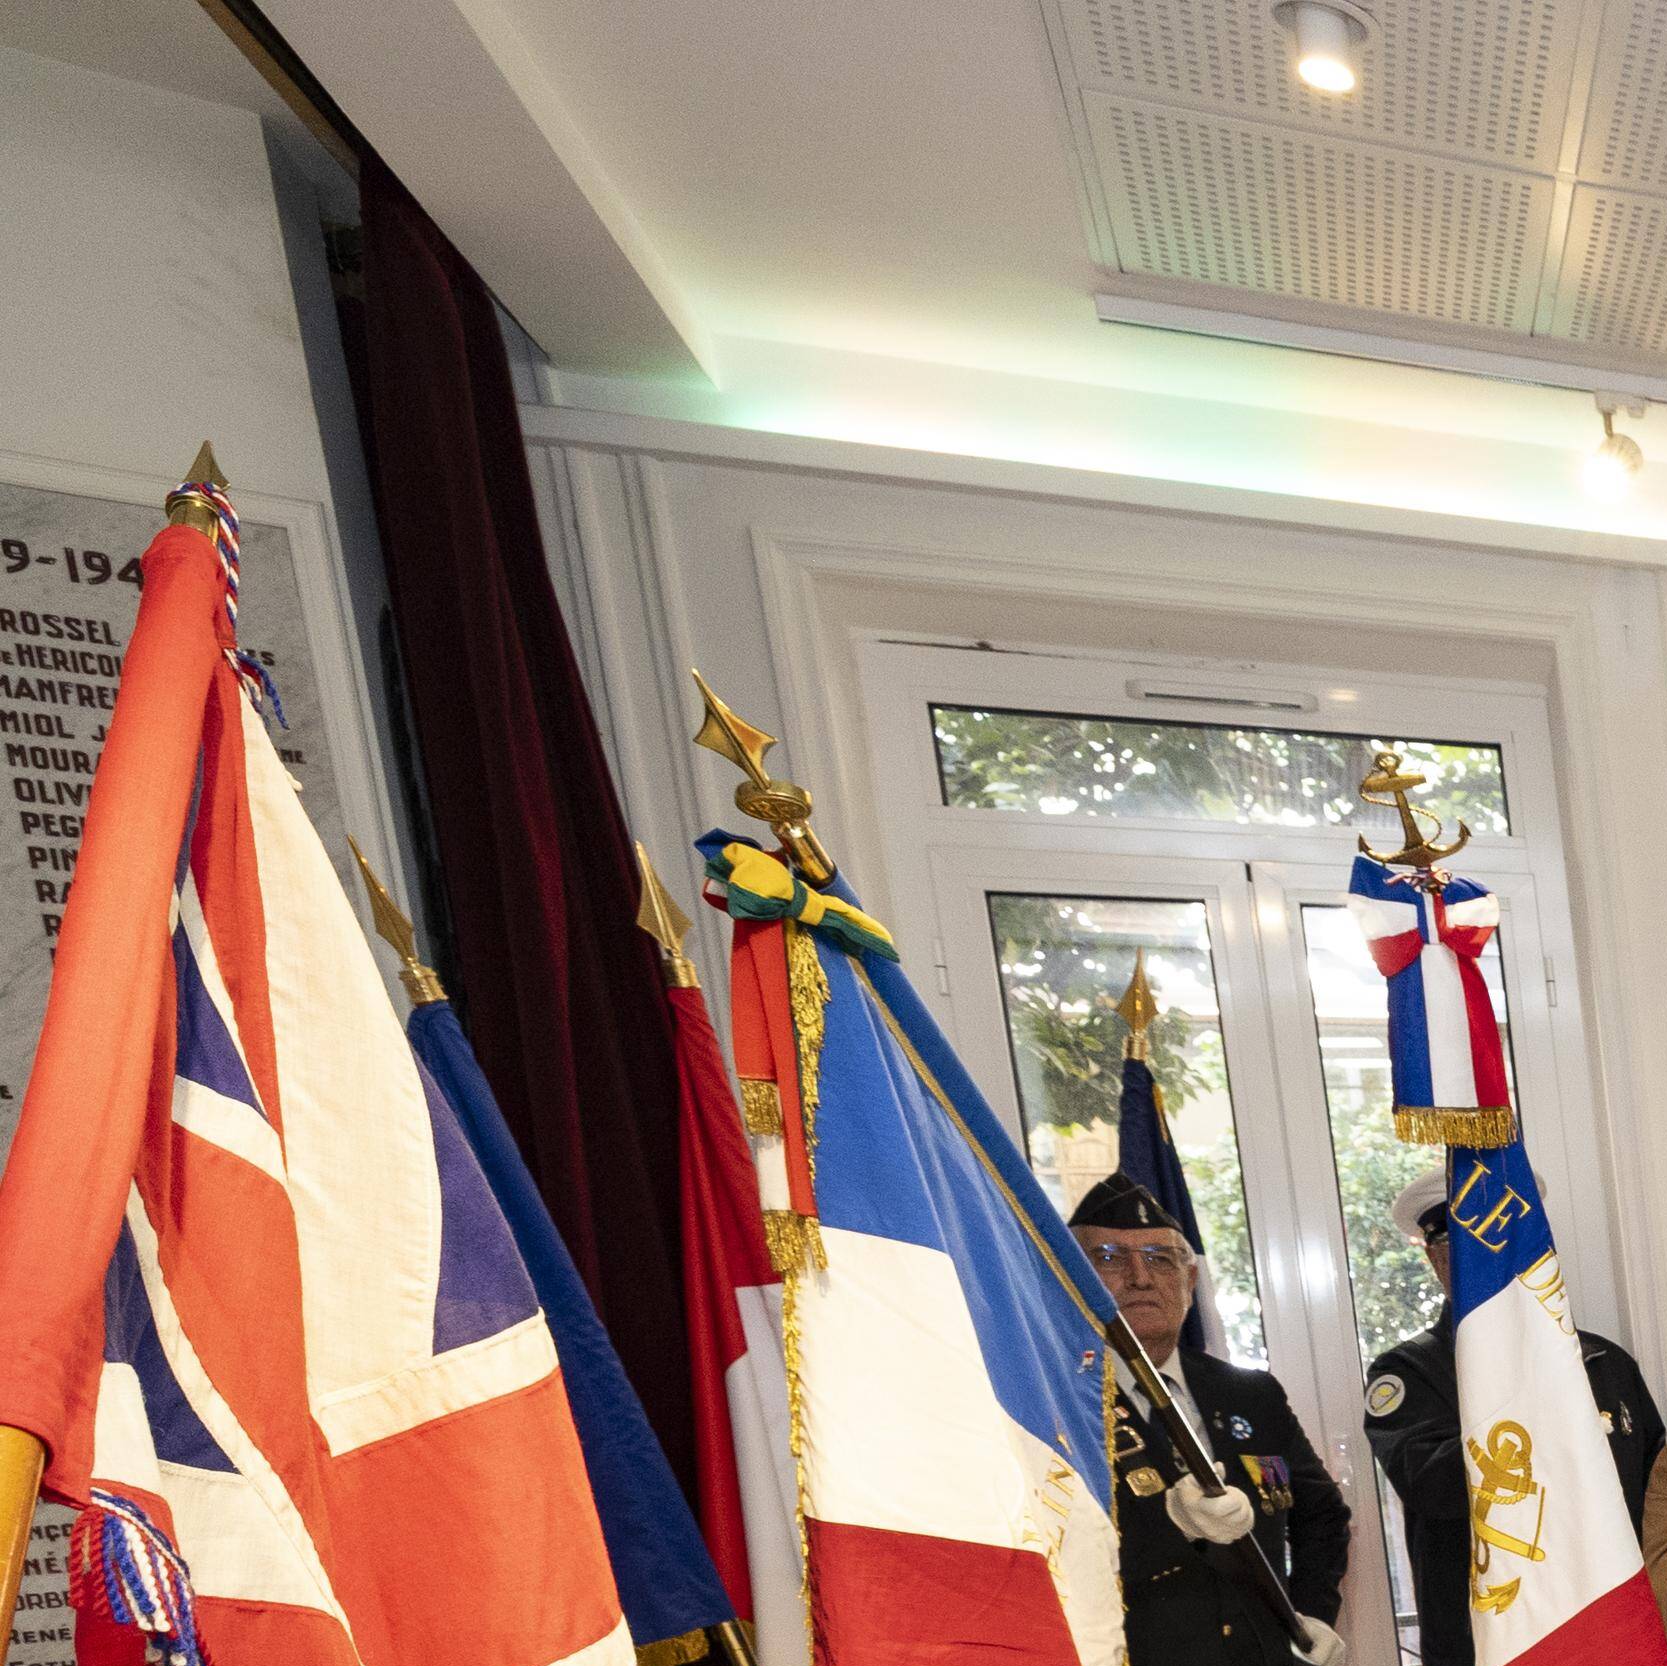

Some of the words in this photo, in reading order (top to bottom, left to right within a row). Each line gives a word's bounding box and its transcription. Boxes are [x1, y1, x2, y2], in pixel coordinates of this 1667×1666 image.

[0, 608, 121, 647] ROSSEL
[0, 674, 119, 710] MANFRE
[0, 709, 75, 739] MIOL
[5, 742, 101, 775] MOUR
[14, 778, 92, 807] OLIV
[20, 811, 85, 838] PEG
